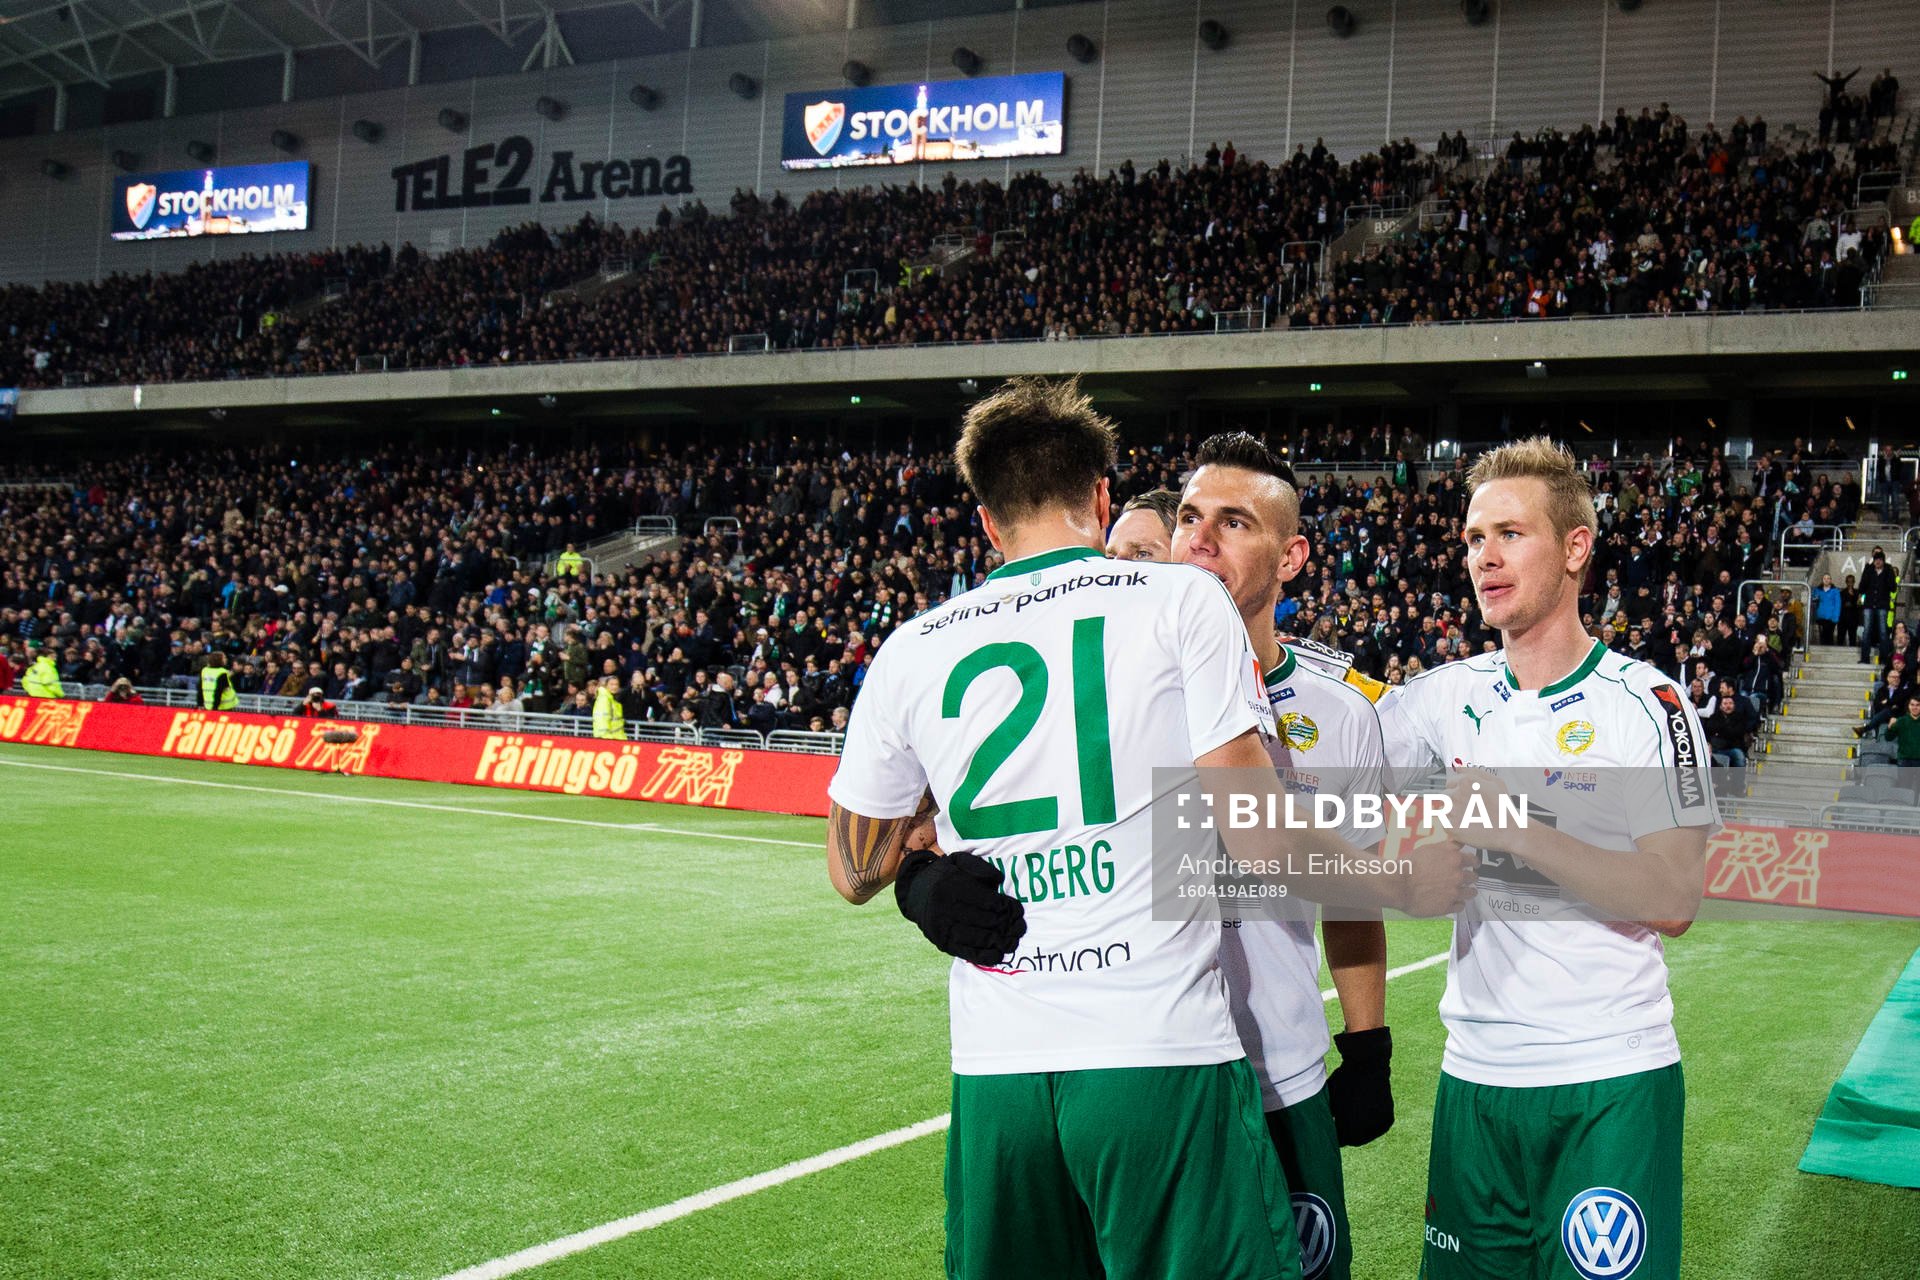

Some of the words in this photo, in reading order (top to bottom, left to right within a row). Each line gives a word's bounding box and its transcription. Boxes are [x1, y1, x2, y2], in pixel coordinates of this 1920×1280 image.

[850, 100, 1044, 140] STOCKHOLM
[391, 135, 533, 212] TELE2
[540, 151, 693, 202] Arena
[158, 184, 295, 216] STOCKHOLM
[919, 601, 1000, 636] Sefina
[1016, 571, 1148, 613] pantbank
[162, 711, 299, 763] Färingsö
[942, 616, 1116, 840] 21
[475, 735, 641, 795] Färingsö
[1286, 769, 1320, 786] INTER
[1563, 771, 1597, 782] INTER
[1669, 710, 1700, 806] YOKOHAMA
[1286, 780, 1319, 795] SPORT
[1563, 782, 1597, 792] SPORT
[988, 839, 1115, 903] LLBERG
[1425, 1224, 1460, 1253] ECON
